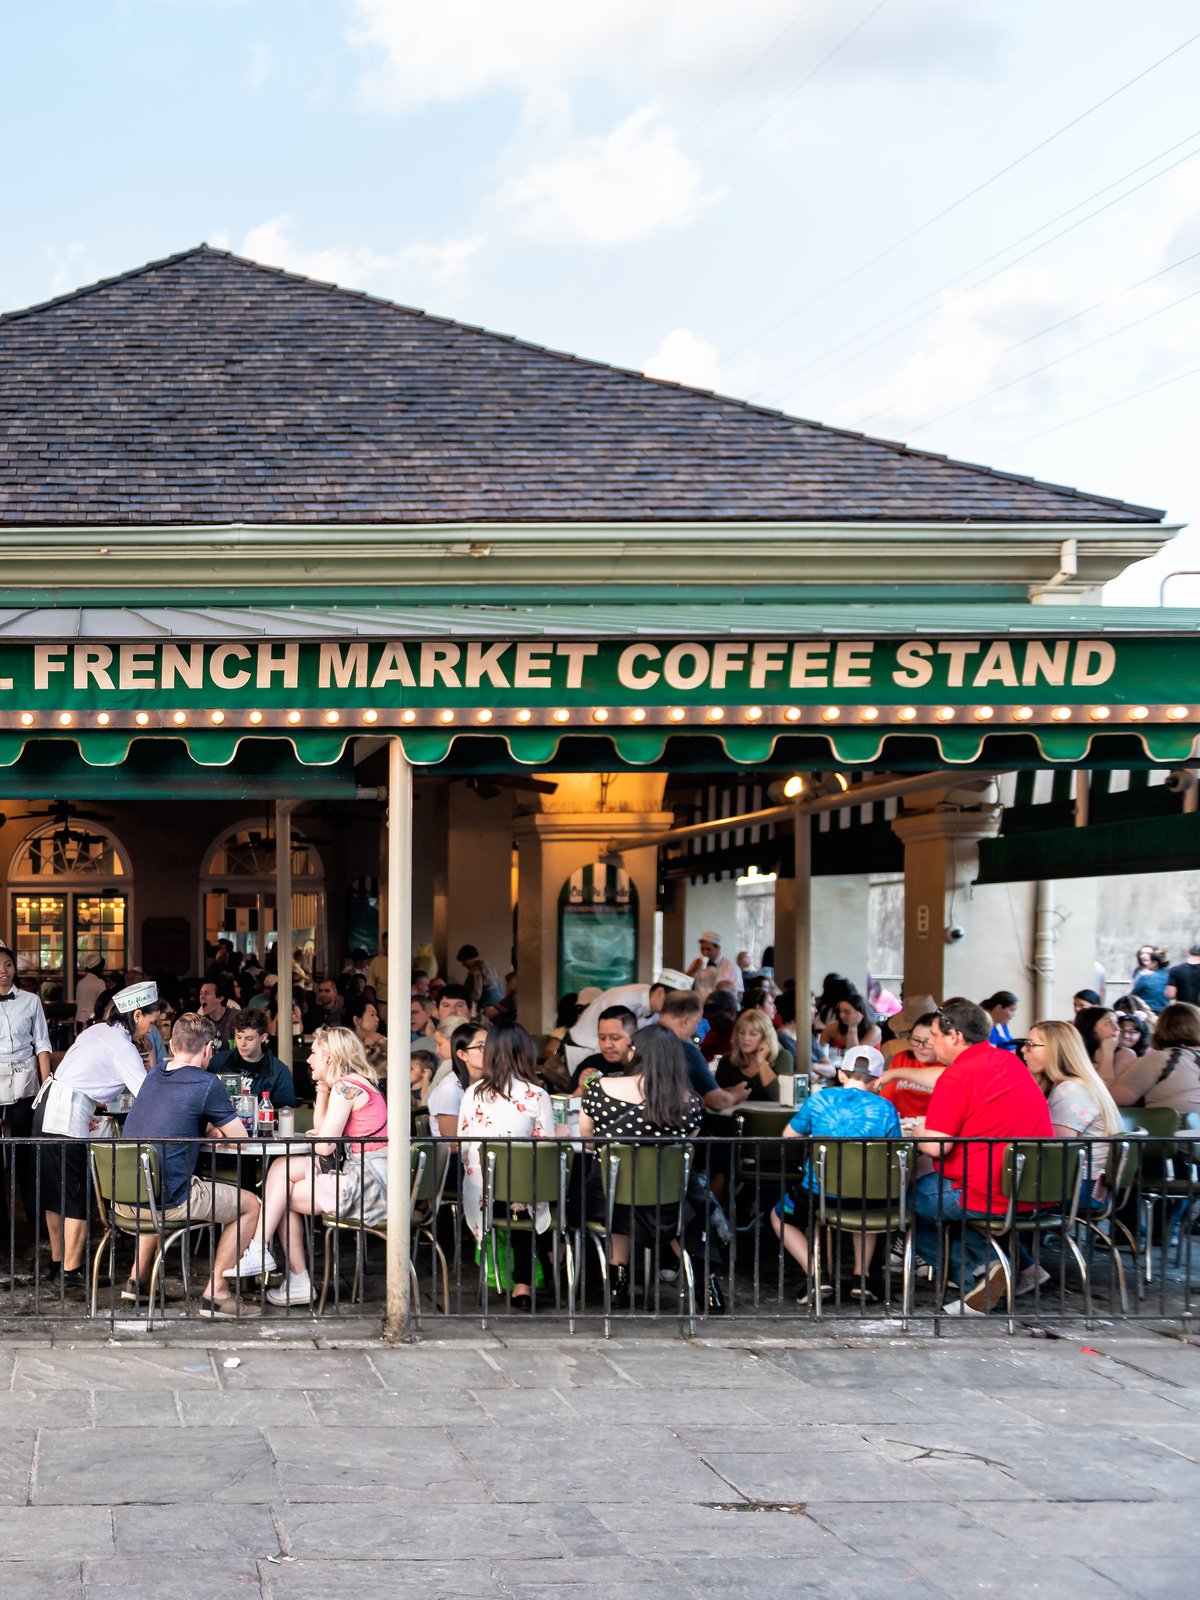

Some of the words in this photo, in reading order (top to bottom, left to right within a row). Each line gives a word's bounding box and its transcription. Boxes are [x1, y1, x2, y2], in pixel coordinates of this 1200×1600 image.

[34, 643, 299, 690] FRENCH
[318, 642, 598, 689] MARKET
[617, 642, 874, 690] COFFEE
[892, 640, 1116, 688] STAND
